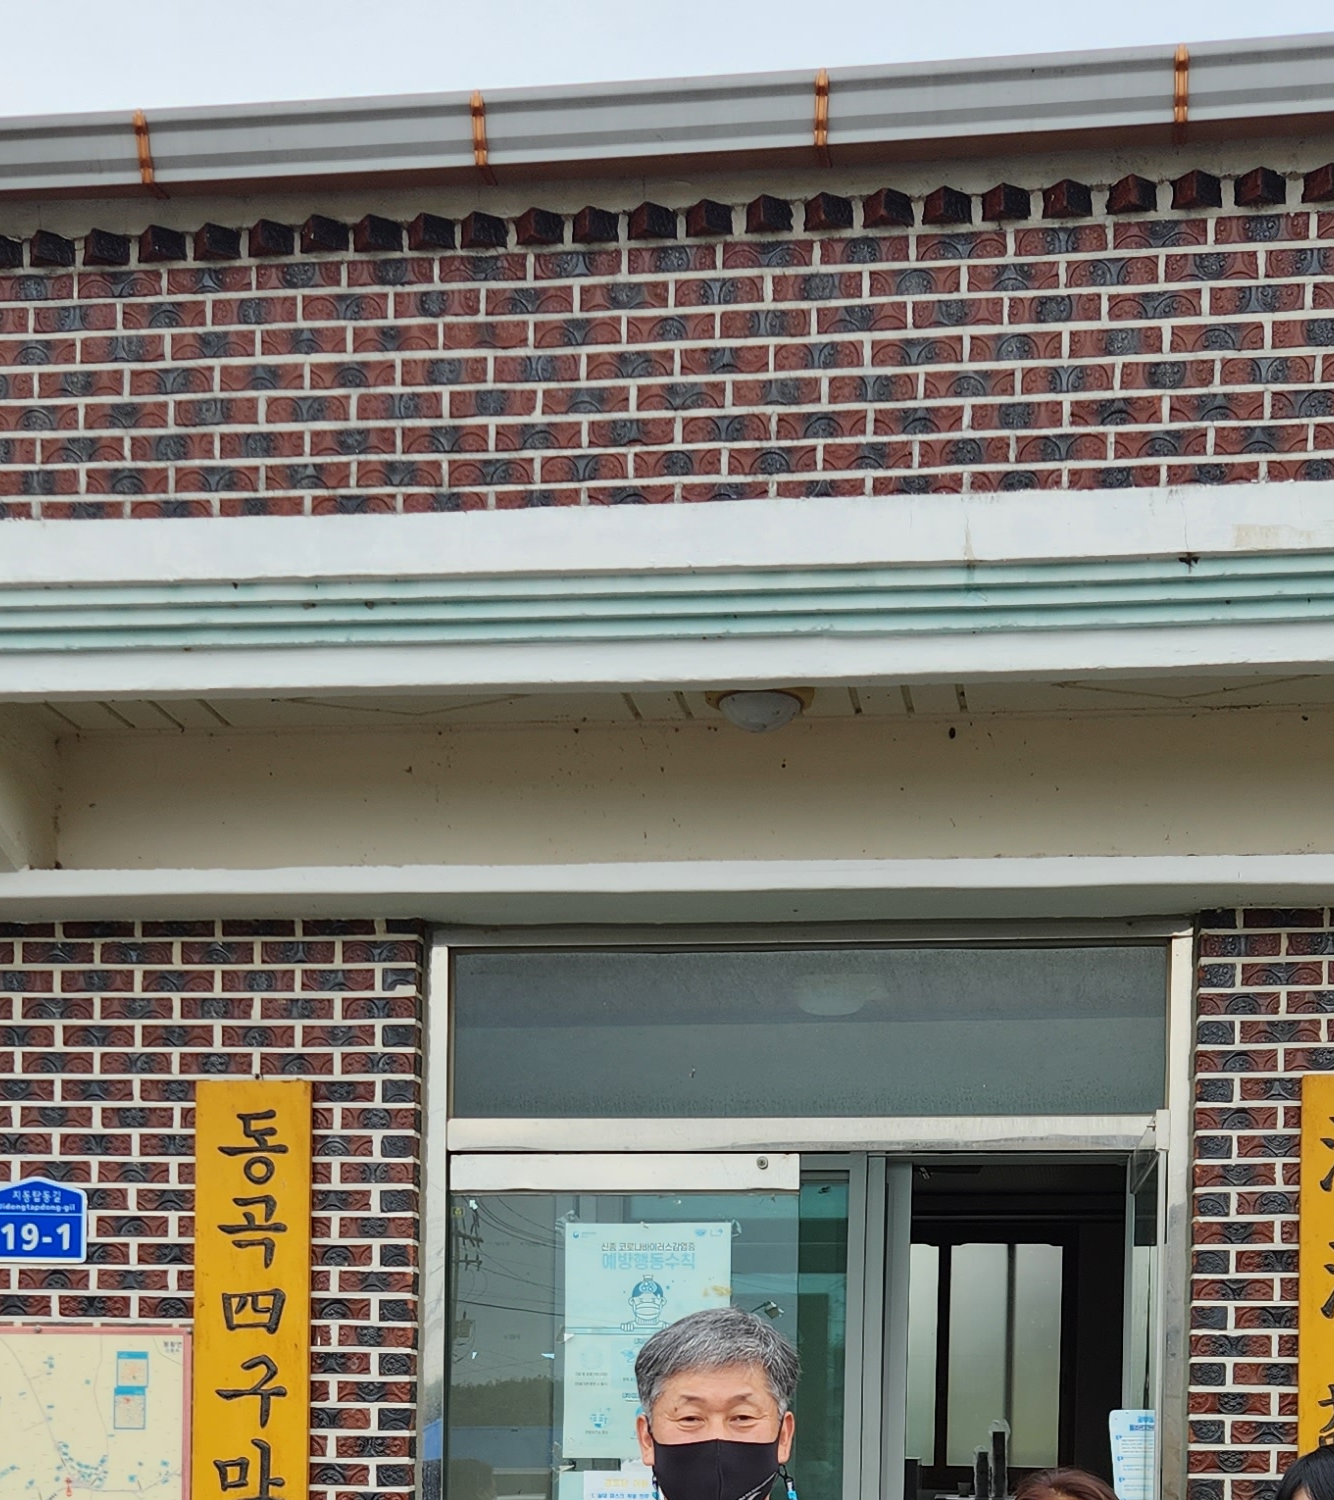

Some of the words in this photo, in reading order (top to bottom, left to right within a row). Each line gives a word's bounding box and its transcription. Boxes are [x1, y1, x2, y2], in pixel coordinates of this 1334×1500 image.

[12, 1190, 62, 1203] 지동탑동길
[0, 1223, 71, 1251] 19-1
[601, 1242, 617, 1252] 신종
[602, 1252, 696, 1271] 예방행동수칙
